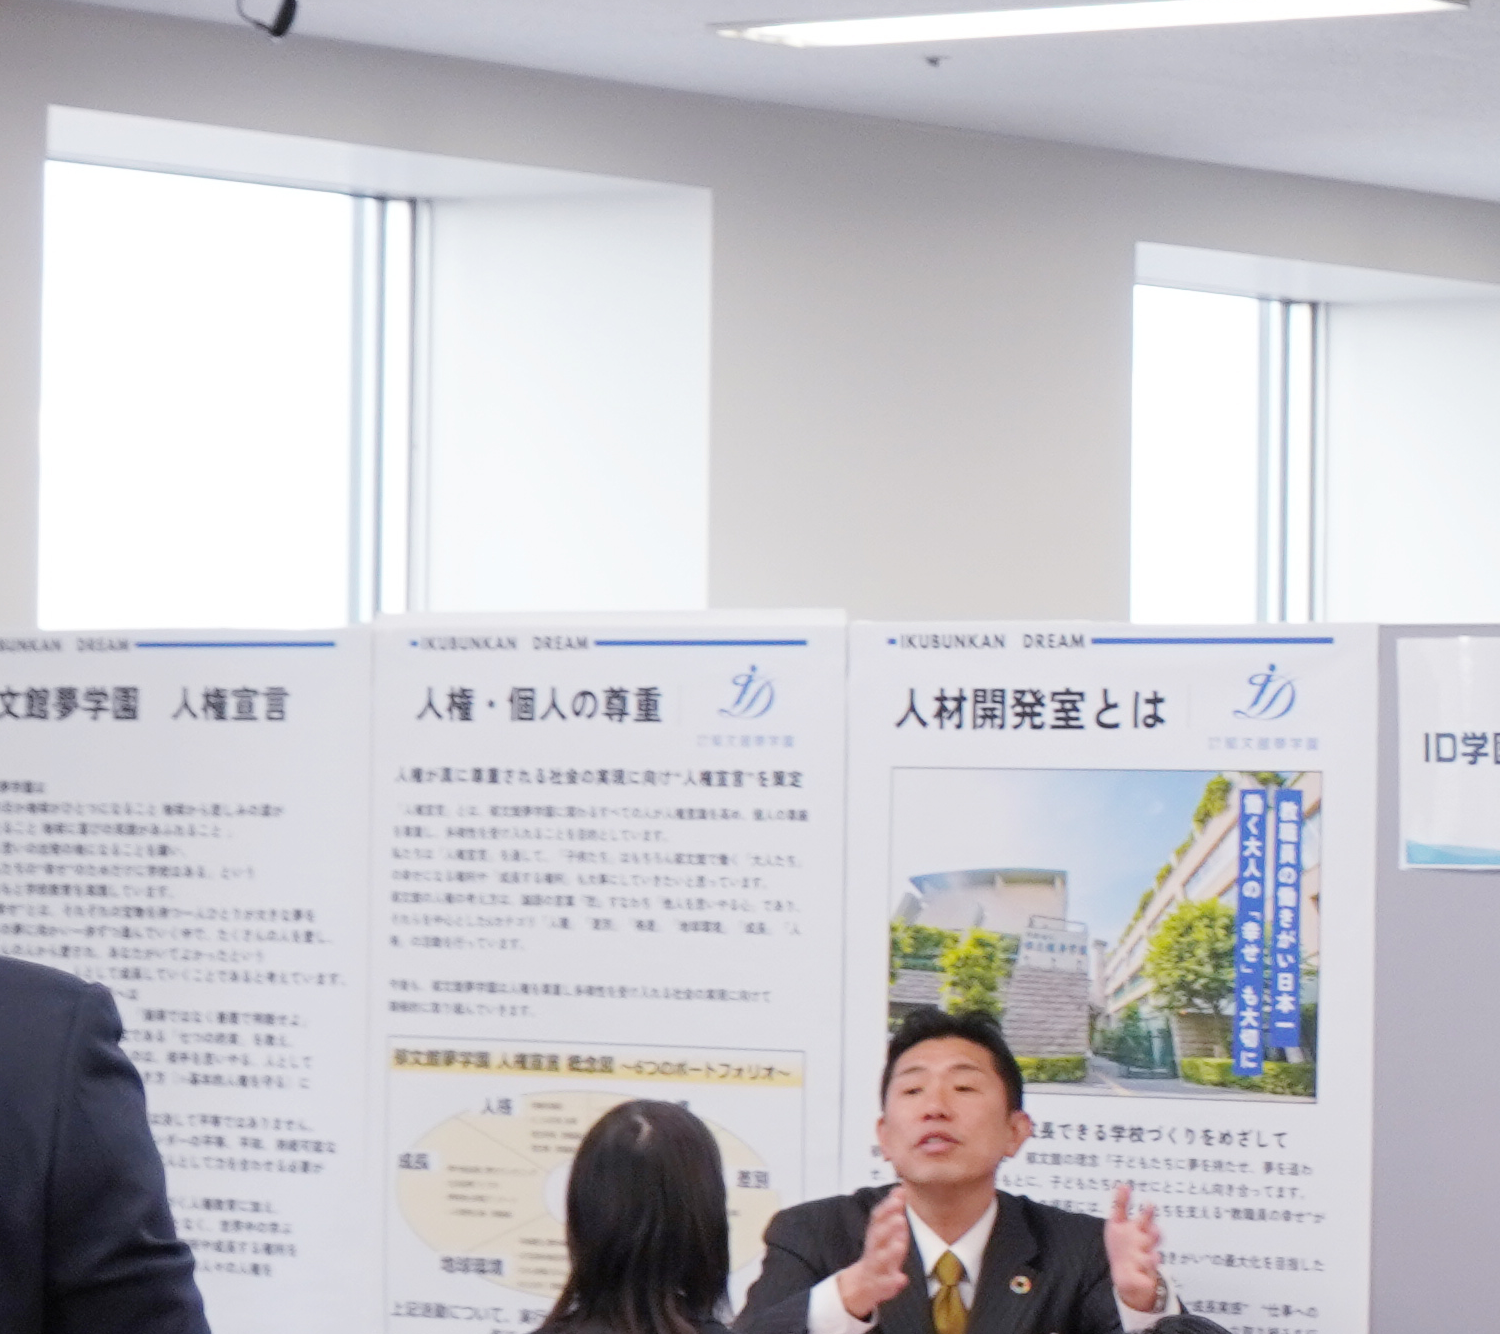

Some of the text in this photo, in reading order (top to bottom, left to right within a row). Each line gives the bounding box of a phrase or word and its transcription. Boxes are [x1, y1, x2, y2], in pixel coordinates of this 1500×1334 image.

[419, 636, 590, 651] IKUBUNKAN DREAM
[900, 632, 1086, 649] IKUBUNKAN DREAM
[171, 685, 290, 722] 人権宣言
[414, 685, 663, 724] 人権・個人の尊重
[894, 687, 1167, 731] 人材開発室とは
